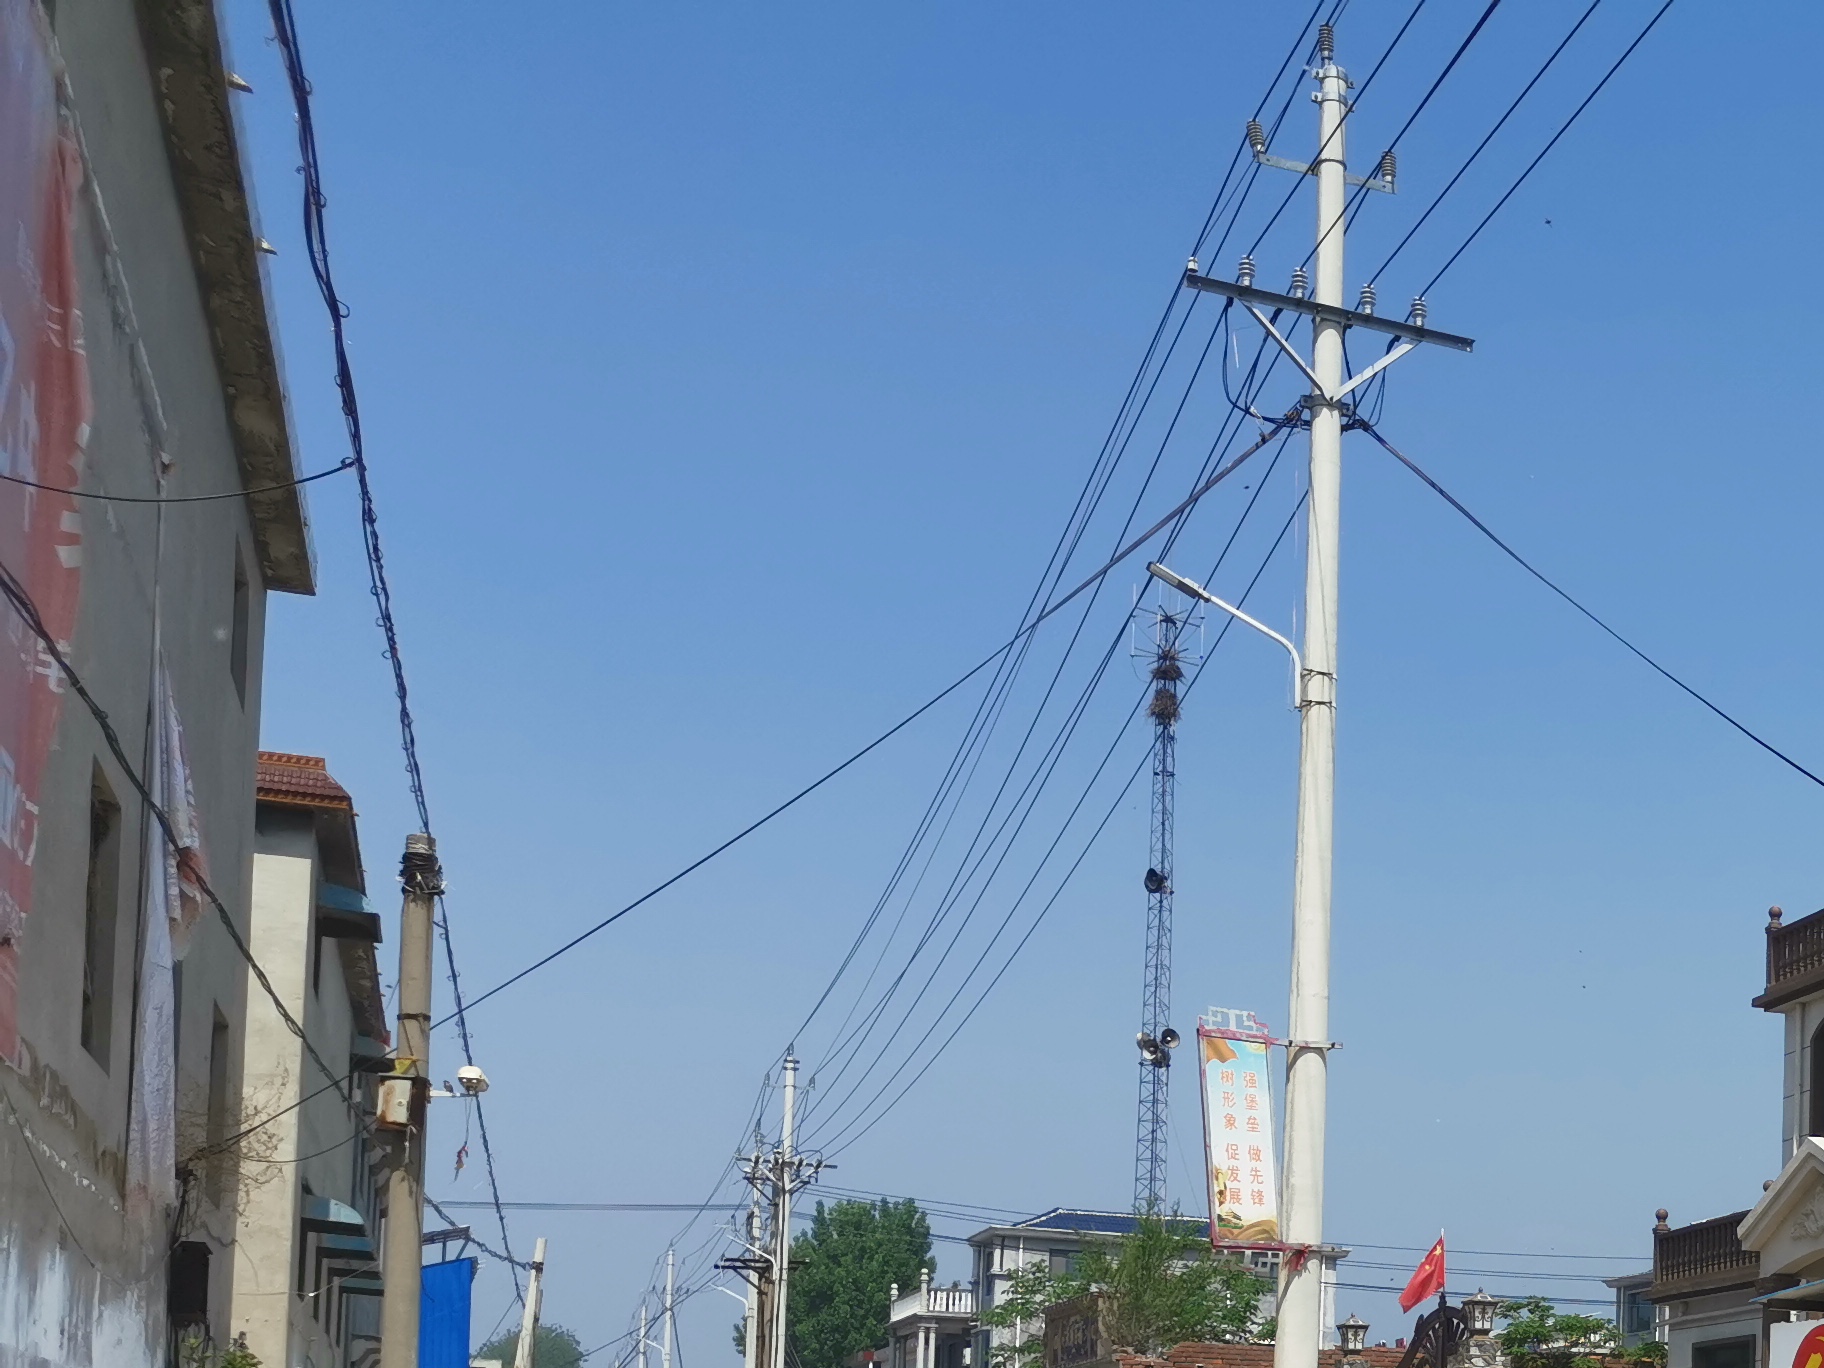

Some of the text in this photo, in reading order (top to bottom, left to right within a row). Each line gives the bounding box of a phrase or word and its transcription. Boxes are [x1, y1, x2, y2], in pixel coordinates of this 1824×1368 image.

[1220, 1069, 1242, 1205] 树形象 促发展
[1243, 1072, 1265, 1206] 强堡垒 做先锋
